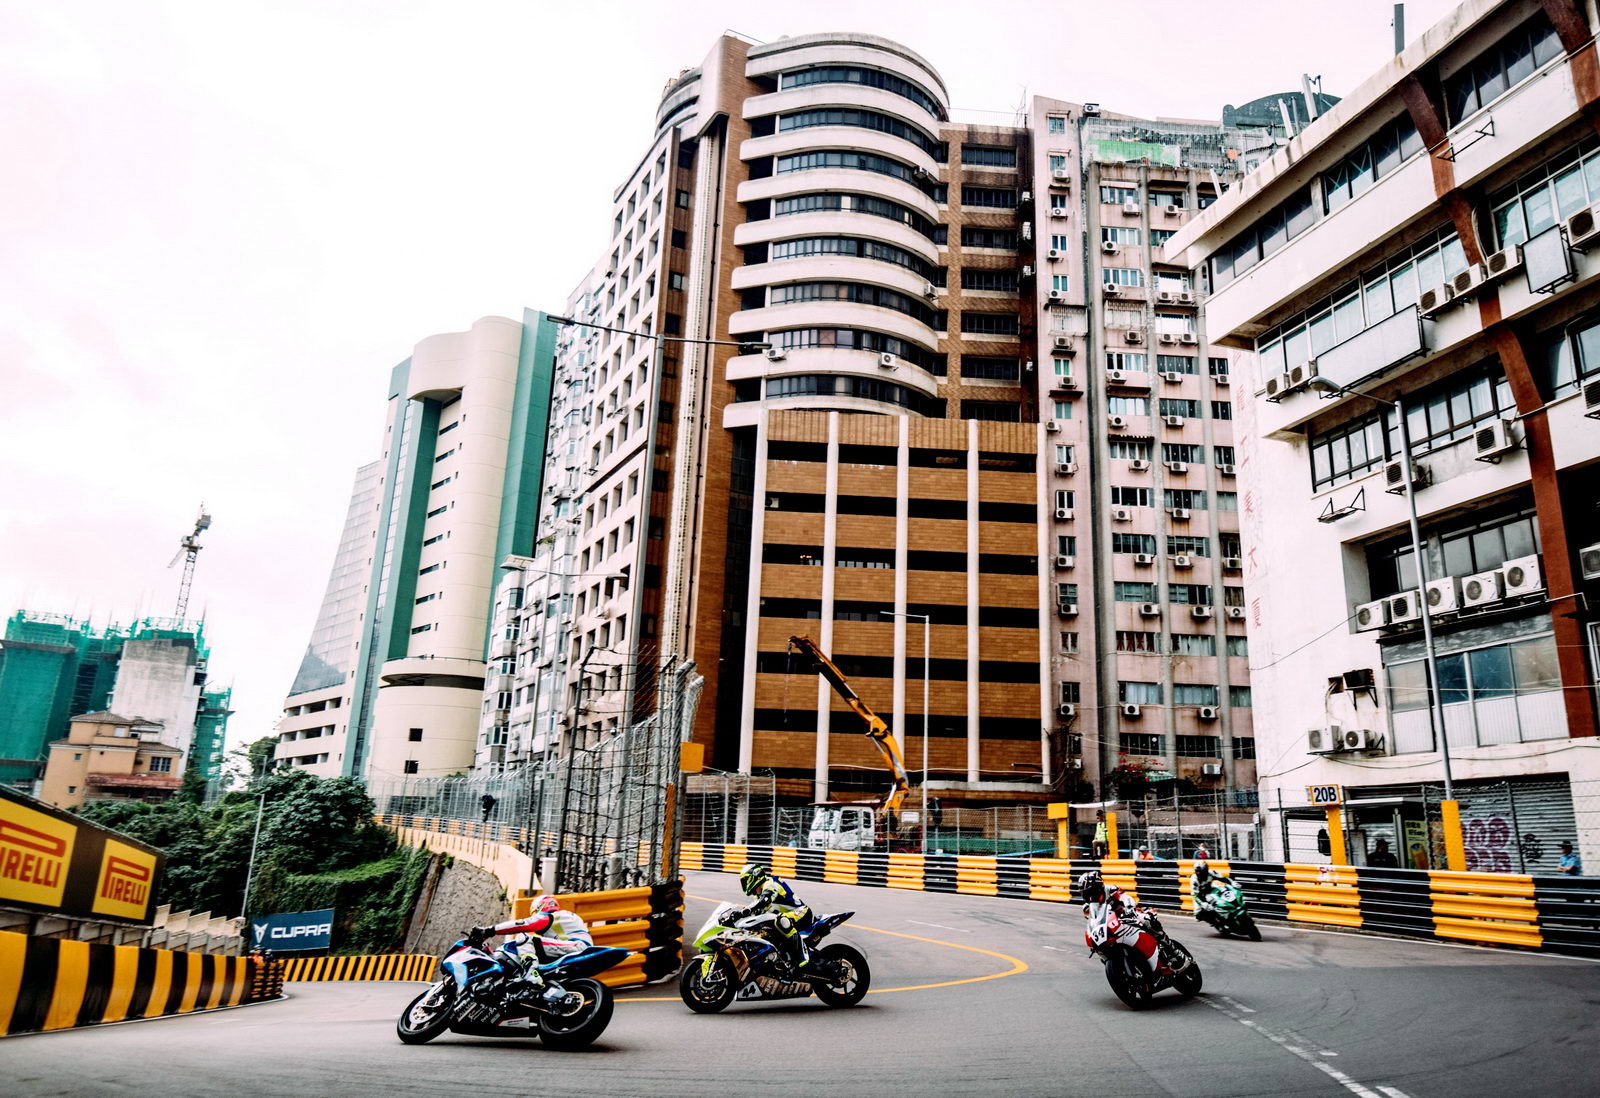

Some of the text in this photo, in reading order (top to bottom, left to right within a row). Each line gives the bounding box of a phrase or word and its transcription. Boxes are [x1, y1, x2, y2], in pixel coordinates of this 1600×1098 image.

[1313, 786, 1337, 803] 20B
[101, 855, 150, 906] PIRELLI
[271, 923, 331, 939] CUPRA
[742, 984, 756, 998] 44
